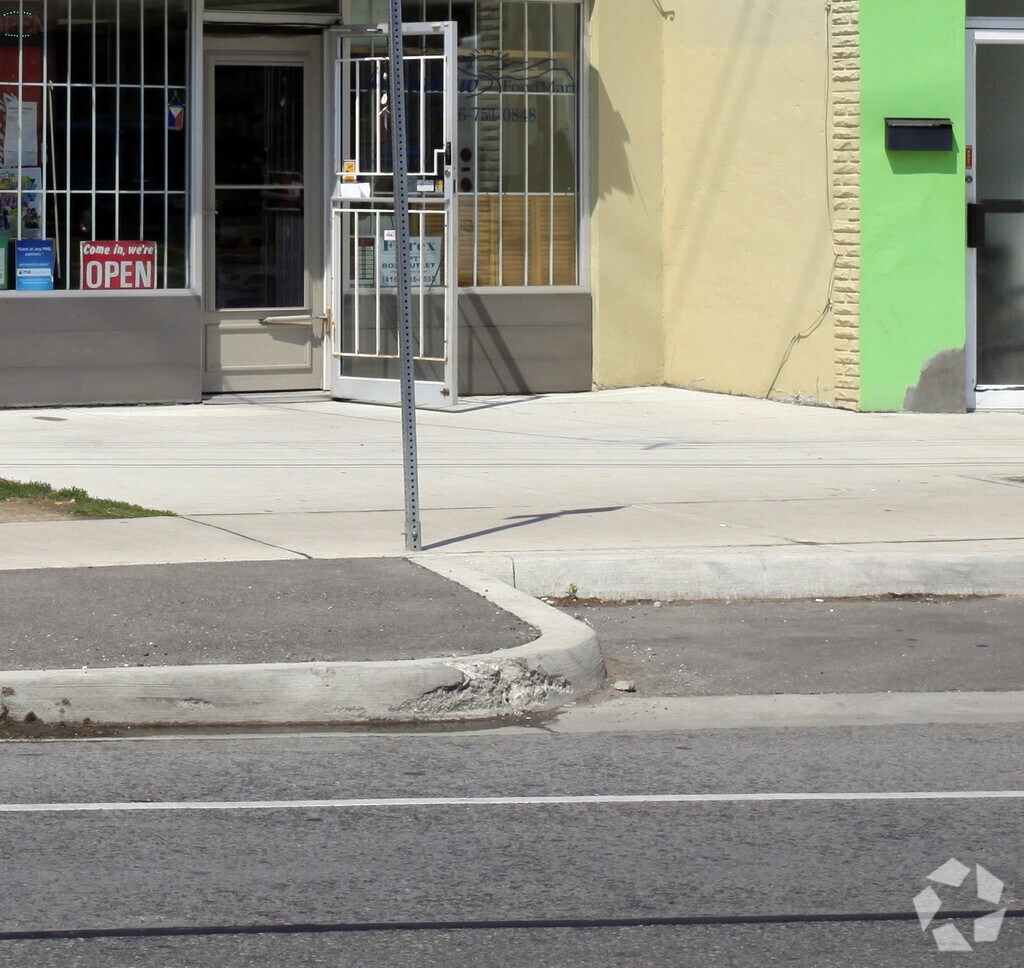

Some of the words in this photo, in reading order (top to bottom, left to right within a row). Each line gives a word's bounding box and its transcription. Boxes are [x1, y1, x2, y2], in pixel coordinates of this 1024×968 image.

[83, 243, 111, 255] Come
[128, 244, 154, 255] we're
[383, 239, 436, 252] Frex
[86, 260, 152, 289] OPEN
